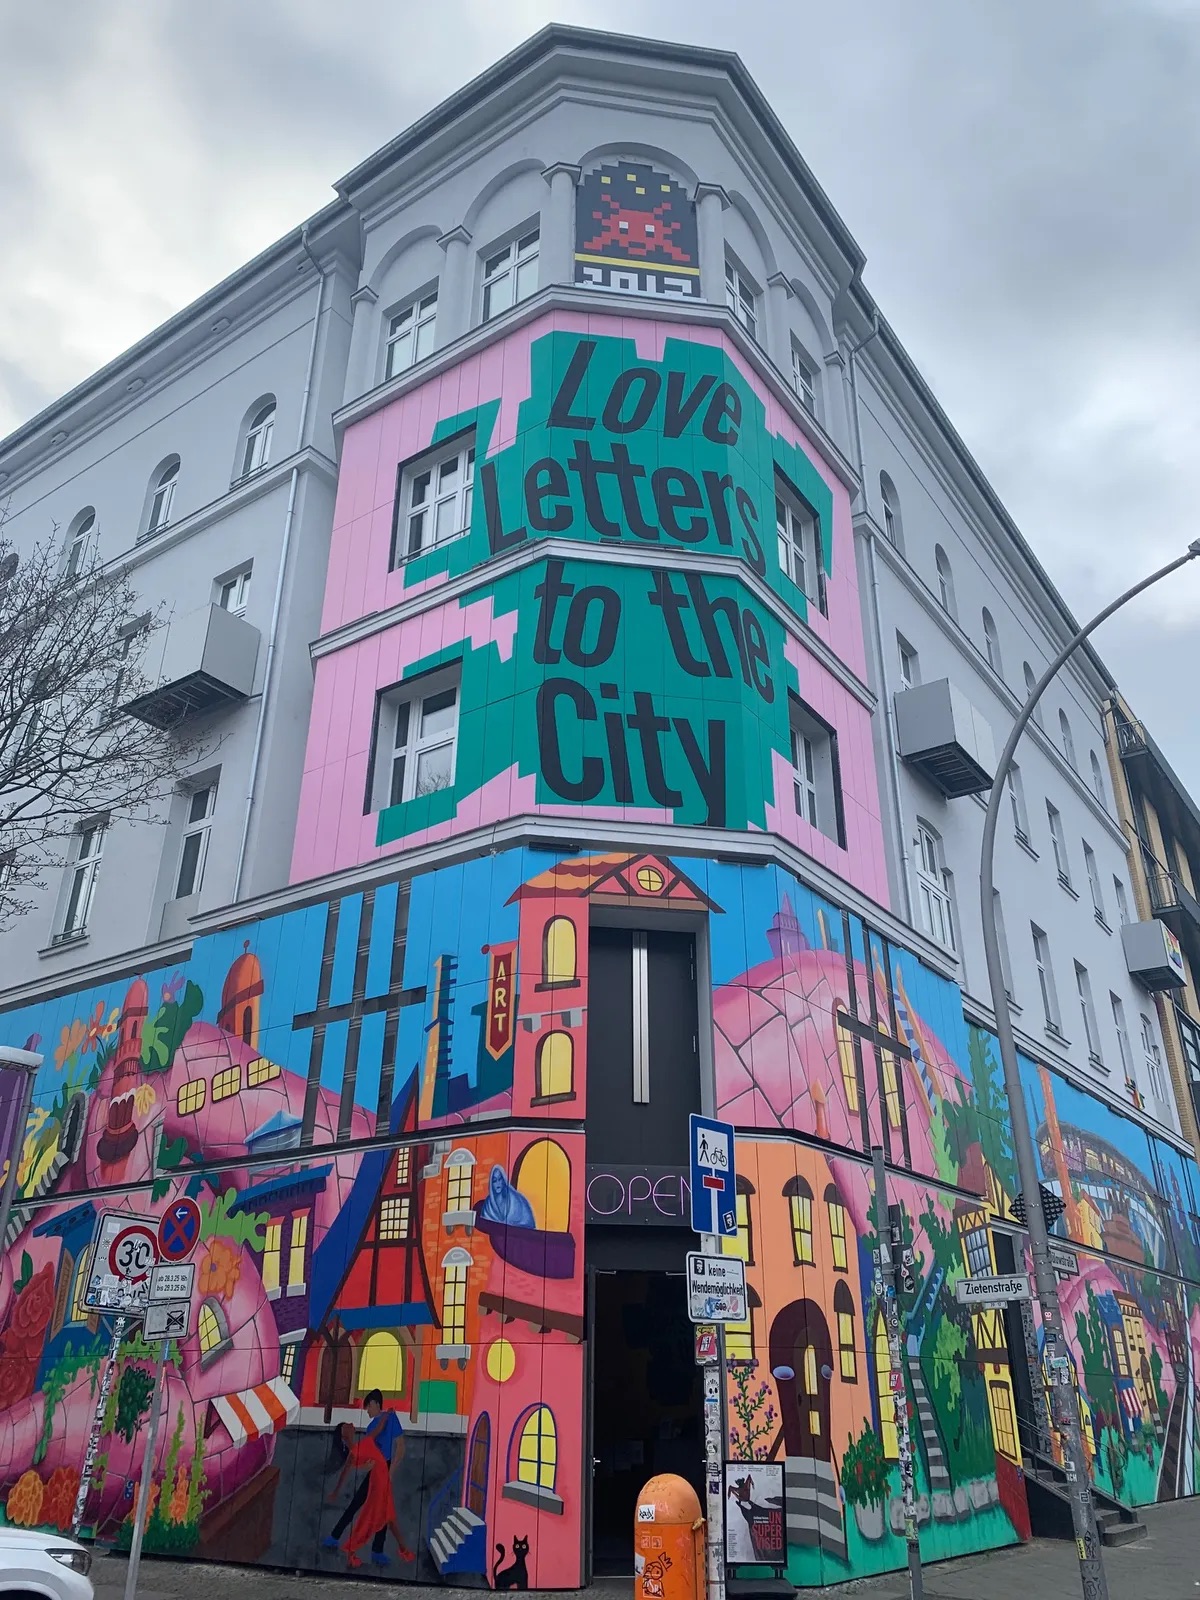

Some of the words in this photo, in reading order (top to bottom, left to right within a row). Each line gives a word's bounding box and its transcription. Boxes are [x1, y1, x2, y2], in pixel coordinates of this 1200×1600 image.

[546, 340, 743, 446] Love
[480, 440, 767, 577] Letters
[532, 560, 622, 668] to
[648, 571, 775, 704] the
[535, 677, 726, 827] City
[493, 960, 508, 1032] ART
[119, 1240, 151, 1269] 30
[708, 1263, 726, 1277] keine
[692, 1279, 744, 1297] Wendemöglichkeit
[964, 1279, 1023, 1295] Zietenstraße
[752, 1524, 782, 1537] SUPER
